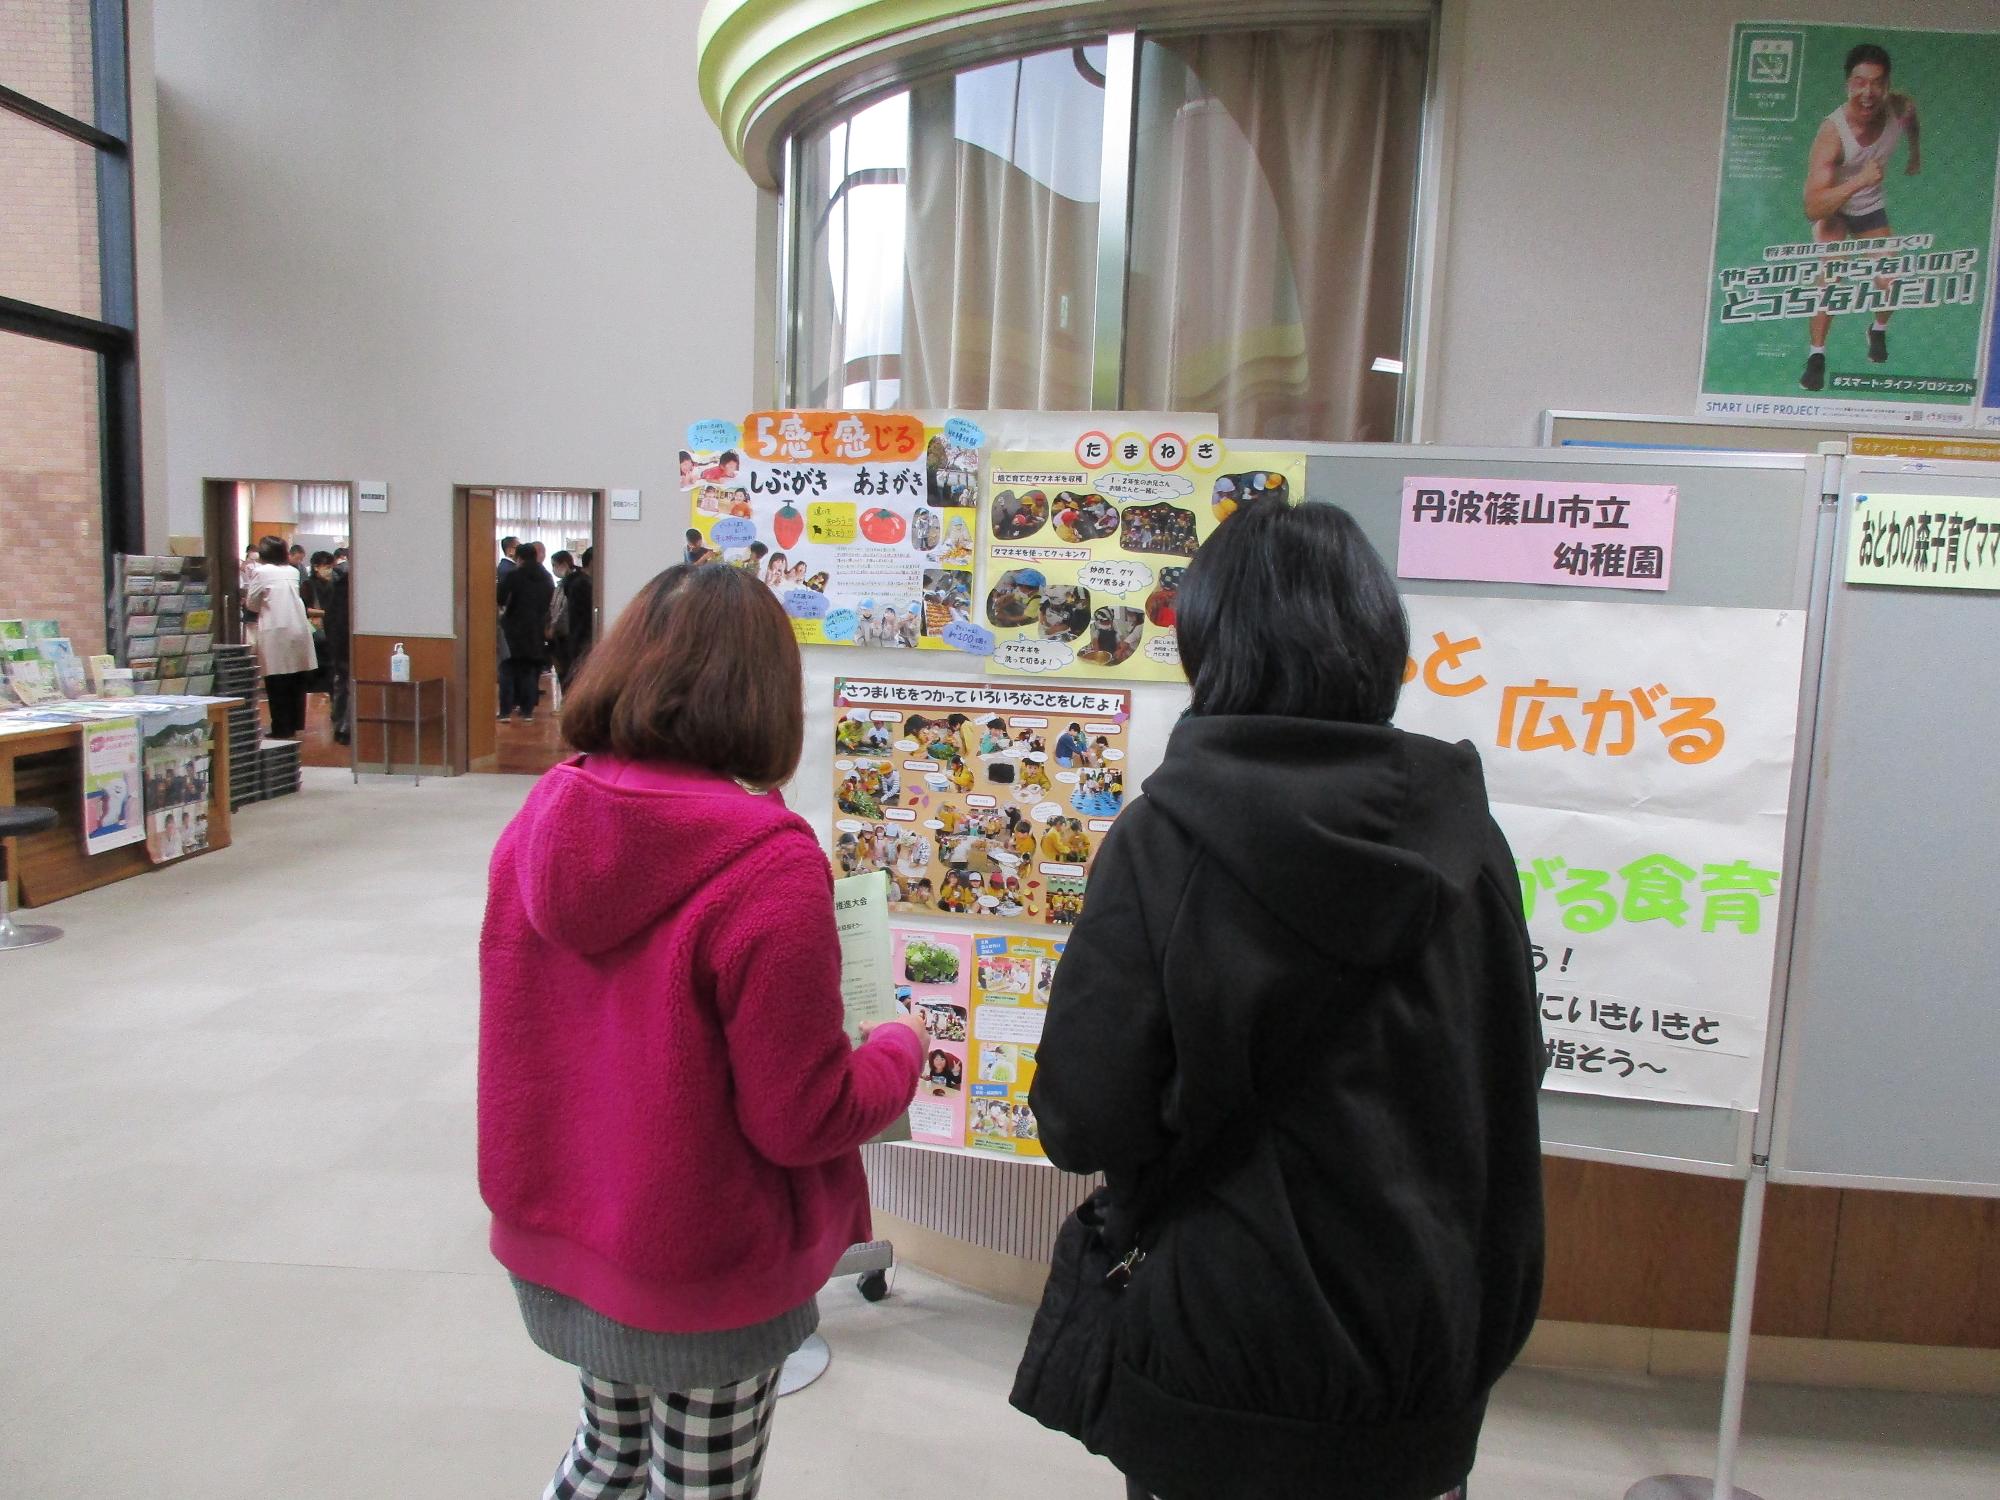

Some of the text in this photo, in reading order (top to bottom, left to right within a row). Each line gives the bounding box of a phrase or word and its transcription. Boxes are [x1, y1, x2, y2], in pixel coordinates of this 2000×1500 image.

[1720, 273, 1974, 321] どっちなんだい！
[1706, 402, 1742, 413] SMART
[1745, 403, 1771, 414] LIFE
[1773, 404, 1821, 416] PROJECT
[757, 414, 915, 459] 5感で感じる
[1086, 442, 1214, 459] たまねぎ
[751, 466, 923, 496] しぶがき あまがき
[1412, 489, 1630, 530] 丹波篠山市立
[1553, 541, 1663, 579] 幼稚園
[1496, 678, 1726, 765] 広がる
